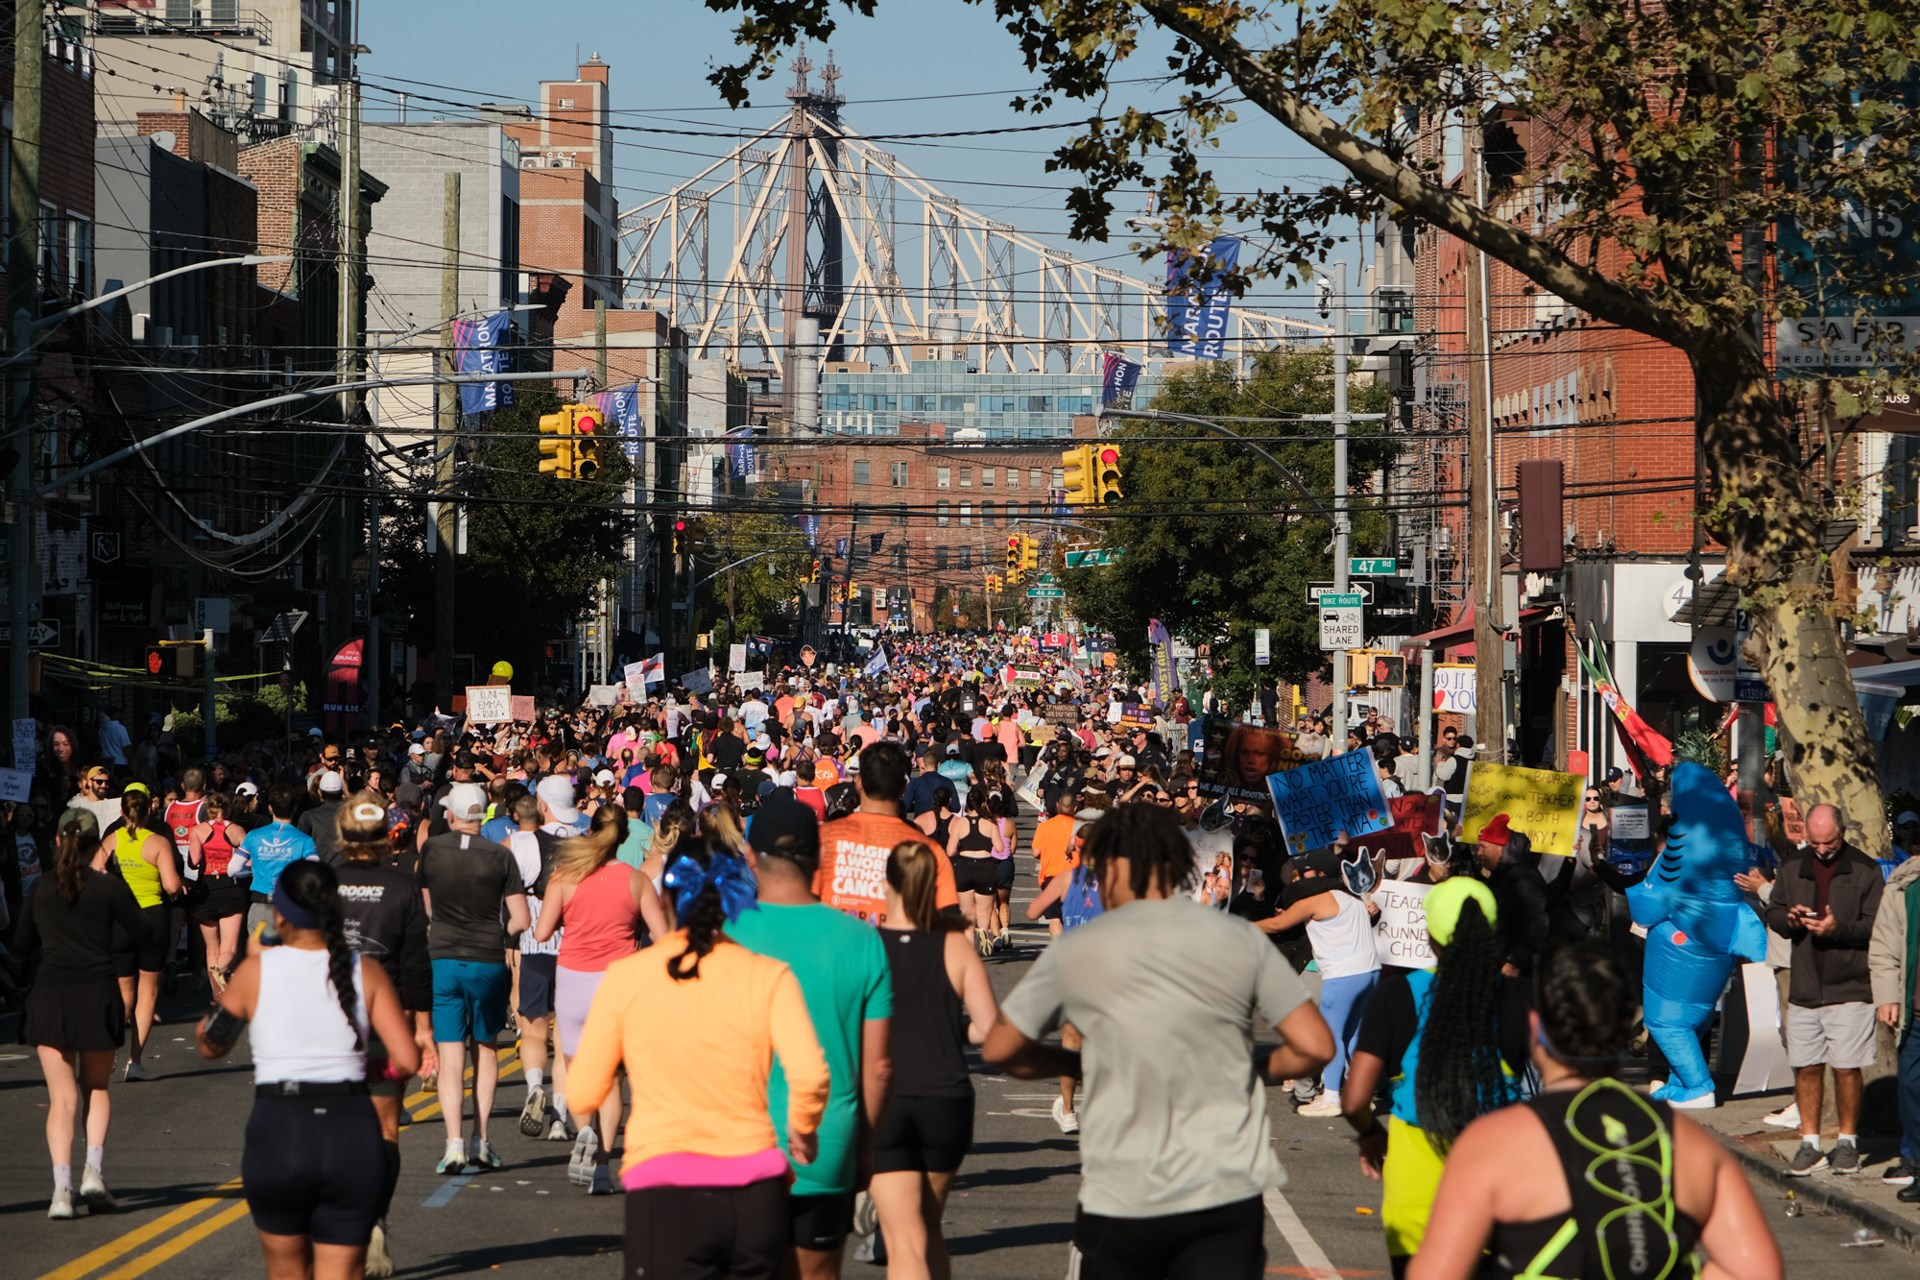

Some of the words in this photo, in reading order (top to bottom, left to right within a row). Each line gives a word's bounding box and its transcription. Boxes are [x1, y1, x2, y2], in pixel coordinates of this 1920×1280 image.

[1203, 289, 1228, 358] ROUTE
[477, 320, 497, 407] MAATHON
[499, 352, 513, 405] ROTE
[1358, 560, 1375, 573] 47
[1322, 597, 1336, 605] BIKE
[1338, 597, 1359, 605] ROUTE
[1323, 625, 1359, 634] SHARED
[1329, 636, 1353, 645] LANE
[478, 700, 503, 710] EMMA
[1447, 690, 1477, 709] YOU
[1274, 771, 1303, 793] NO
[1308, 752, 1364, 784] MATTER
[1534, 771, 1575, 787] BADASS
[1211, 784, 1226, 794] ARE
[1227, 786, 1240, 796] ALL
[1278, 786, 1314, 812] WHAT
[1325, 772, 1368, 799] YOU'RE
[1529, 791, 1576, 808] TEACHER
[1284, 802, 1334, 833] FASTER
[1335, 791, 1372, 818] THAN
[1526, 811, 1560, 825] BOTH
[1308, 822, 1339, 846] THE
[1342, 811, 1374, 836] MTA
[258, 846, 293, 854] FRANCE
[836, 840, 891, 858] IMAGIN
[836, 854, 846, 865] A
[848, 855, 888, 870] WOR
[835, 866, 887, 882] WITHO
[337, 885, 385, 897] ROOKS
[1381, 890, 1424, 910] TEACH
[1378, 921, 1427, 942] RUNNE
[1390, 941, 1432, 958] CHOI
